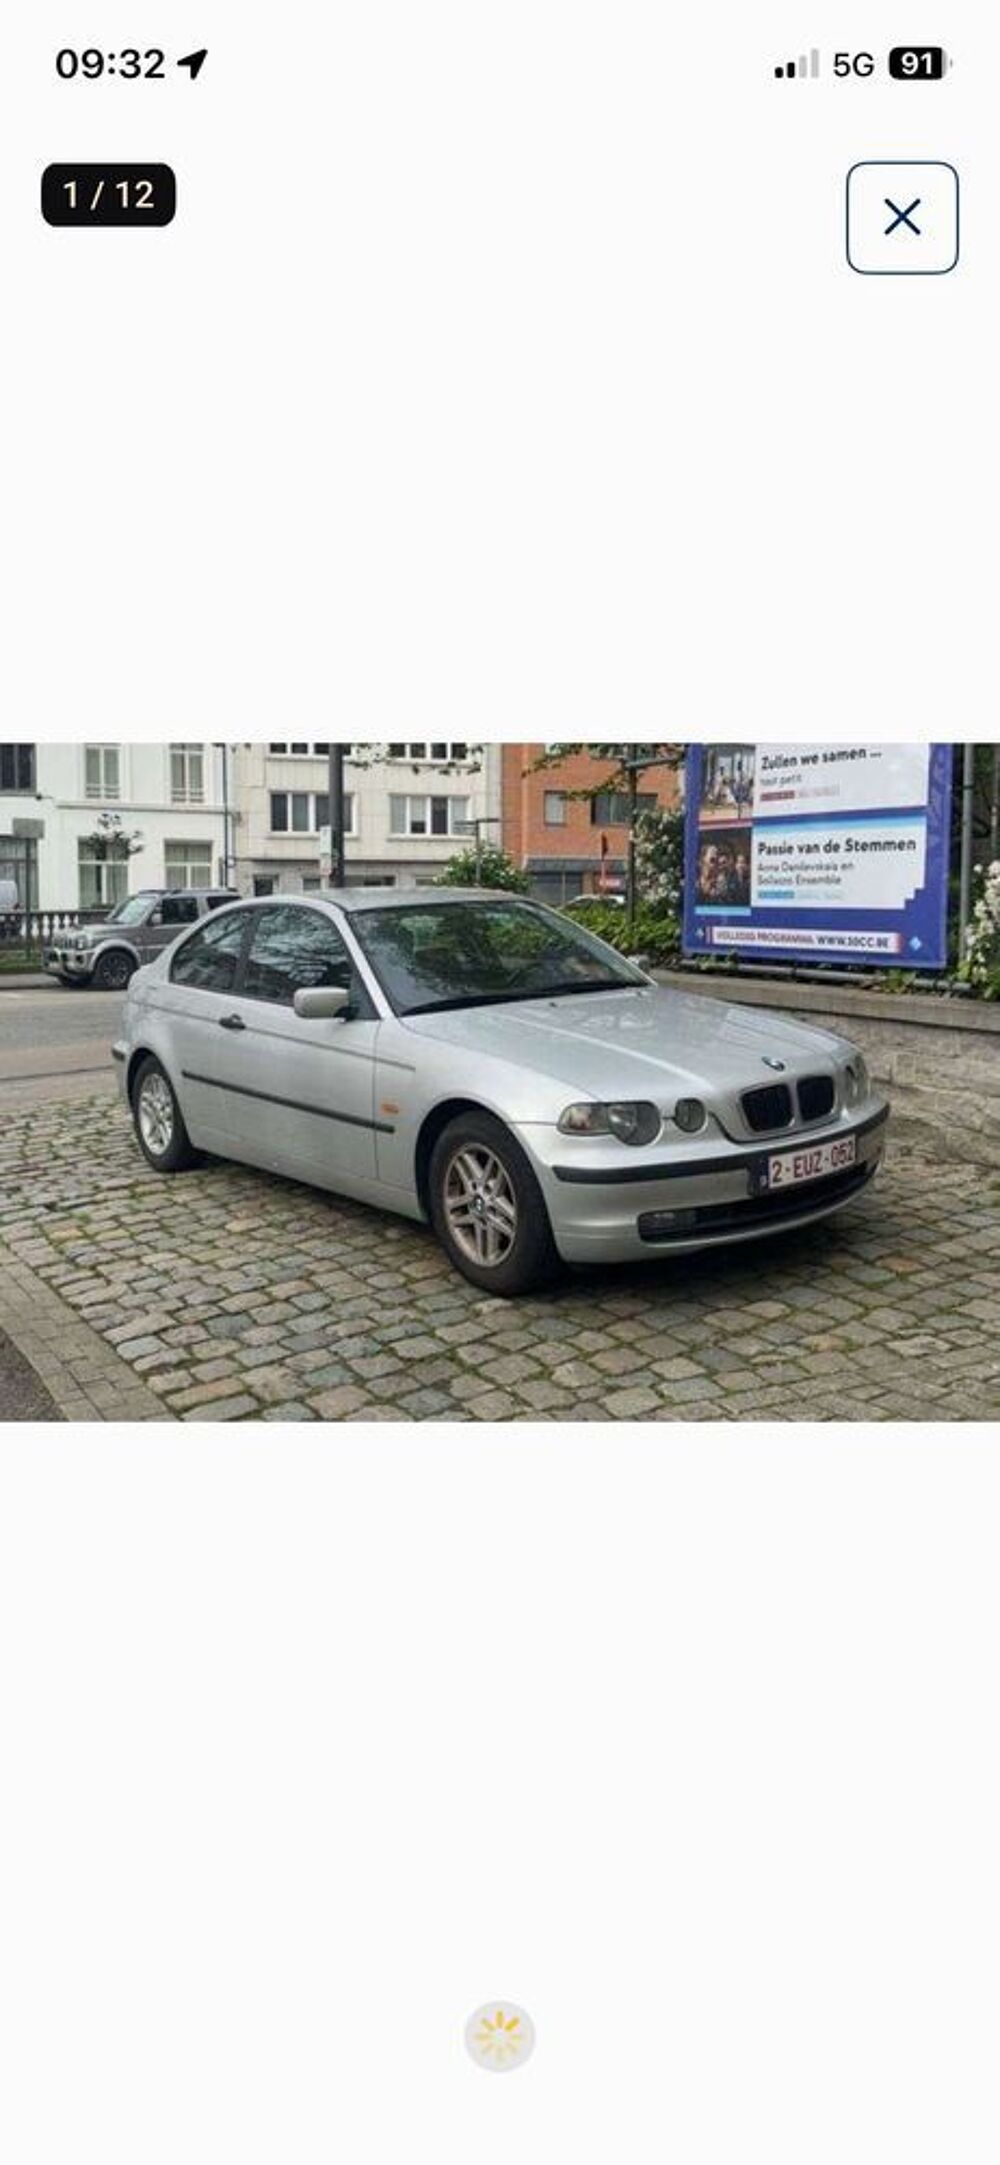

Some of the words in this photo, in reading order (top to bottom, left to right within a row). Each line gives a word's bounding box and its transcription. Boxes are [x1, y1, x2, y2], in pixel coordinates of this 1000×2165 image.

[55, 48, 165, 79] 09:32
[834, 52, 875, 78] 5G
[901, 51, 933, 75] 91
[64, 181, 76, 208] 1
[116, 180, 154, 208] 12
[761, 755, 798, 770] Zullen
[800, 754, 819, 765] we
[821, 749, 867, 763] samen
[757, 841, 794, 855] Passie
[796, 843, 820, 854] van
[822, 839, 841, 853] de
[845, 838, 917, 852] Stemmen
[841, 862, 854, 870] en
